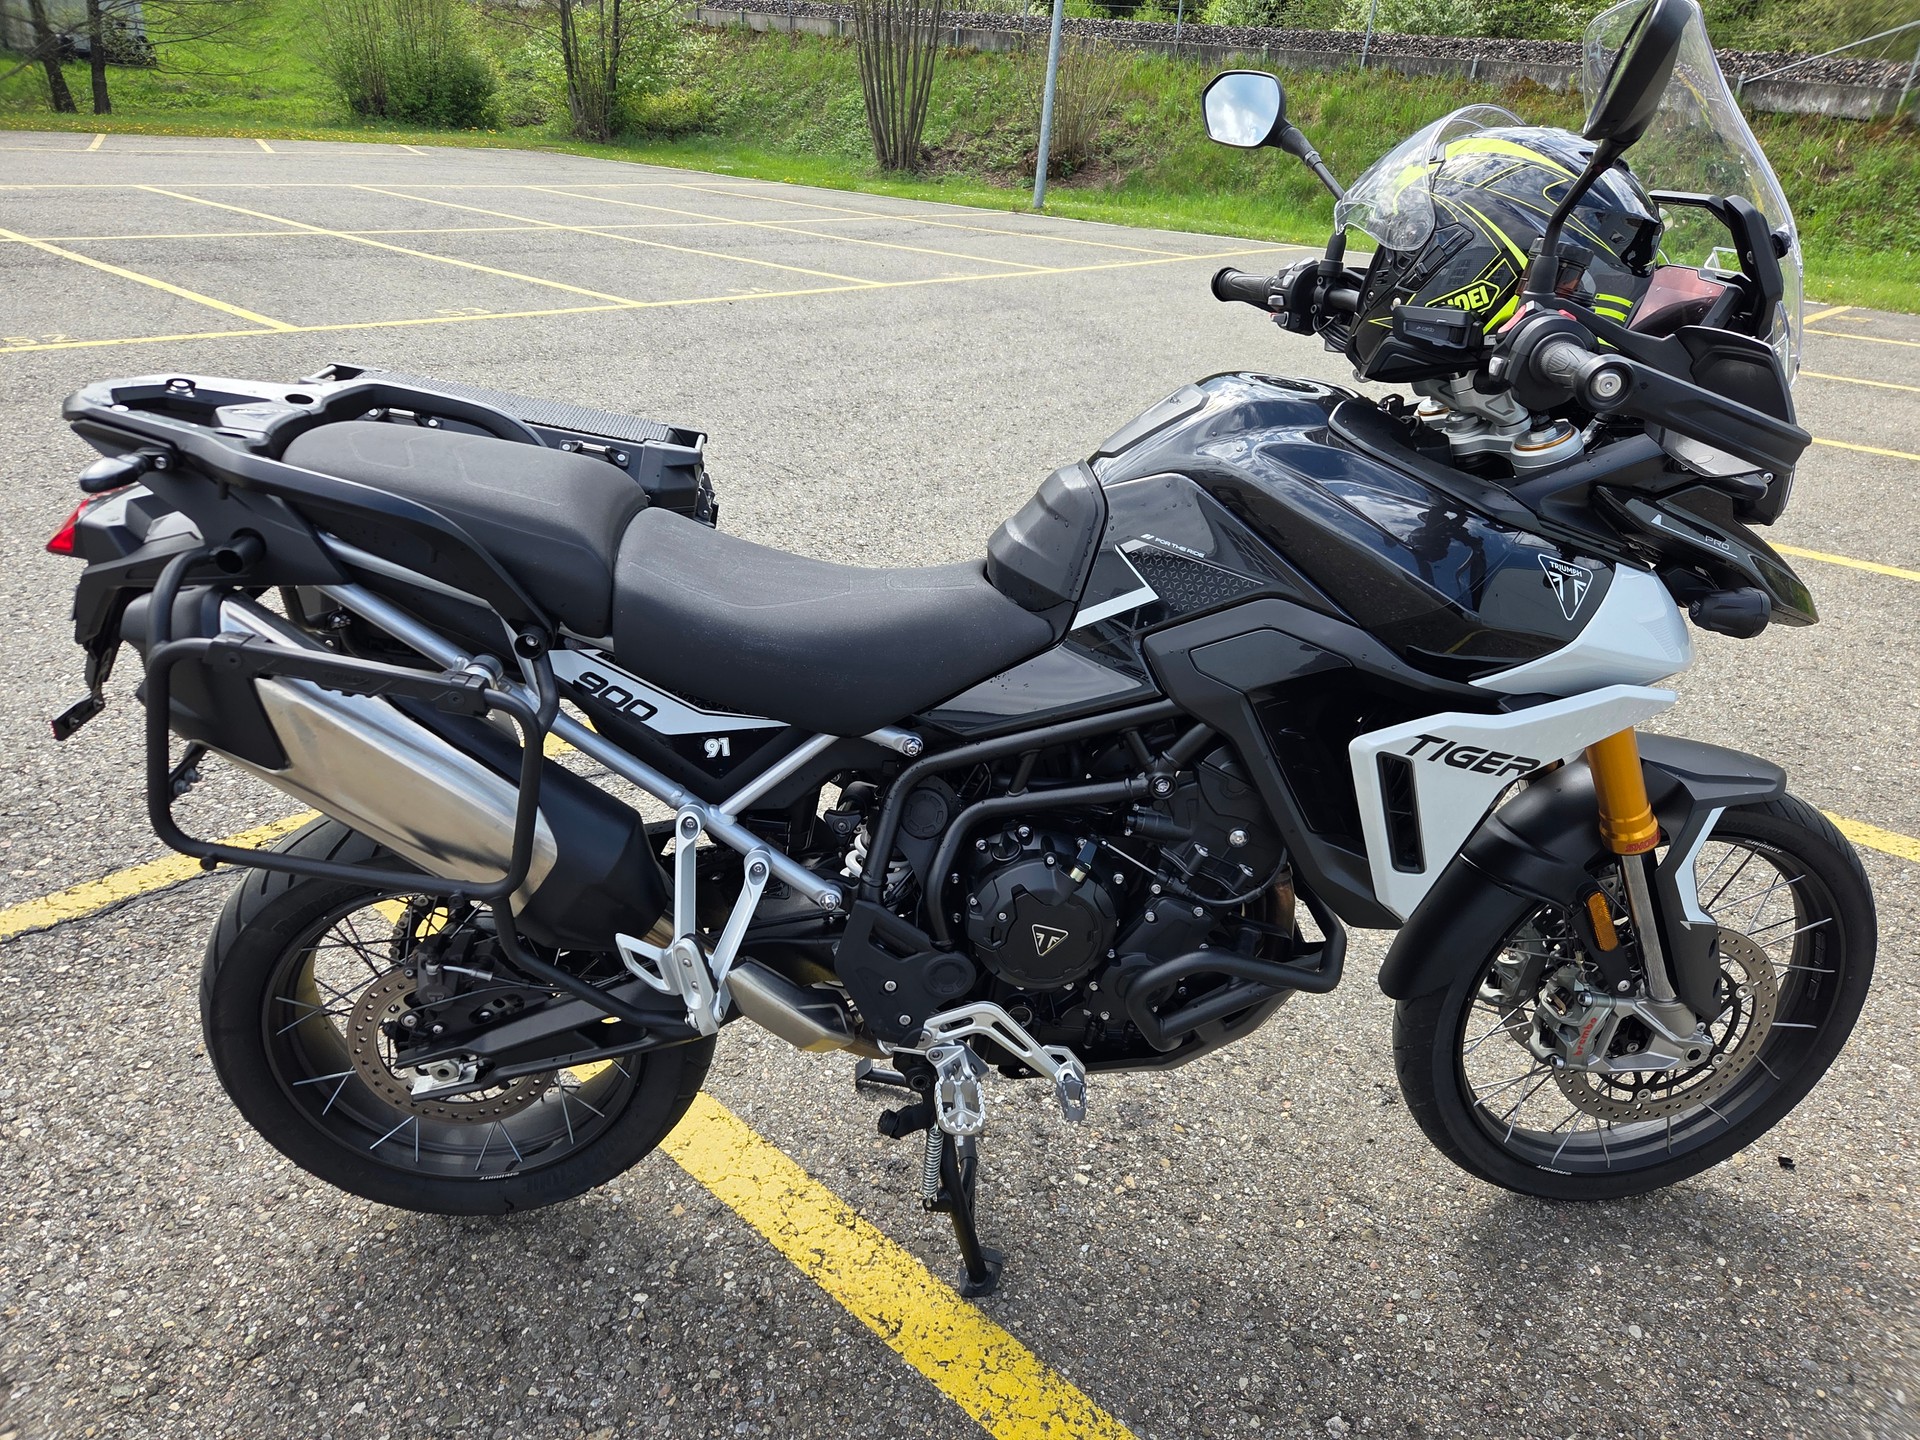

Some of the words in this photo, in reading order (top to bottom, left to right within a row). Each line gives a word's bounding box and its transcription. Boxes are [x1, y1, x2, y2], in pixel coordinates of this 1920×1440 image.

[1155, 537, 1171, 547] FOR
[1171, 542, 1187, 552] THE
[1186, 548, 1205, 558] RIDE
[1705, 534, 1730, 550] PRO
[1549, 560, 1583, 578] TRIUMPH
[572, 671, 659, 722] 900
[704, 737, 731, 759] 91
[1405, 733, 1541, 777] TIGER
[1573, 1017, 1598, 1057] brembo
